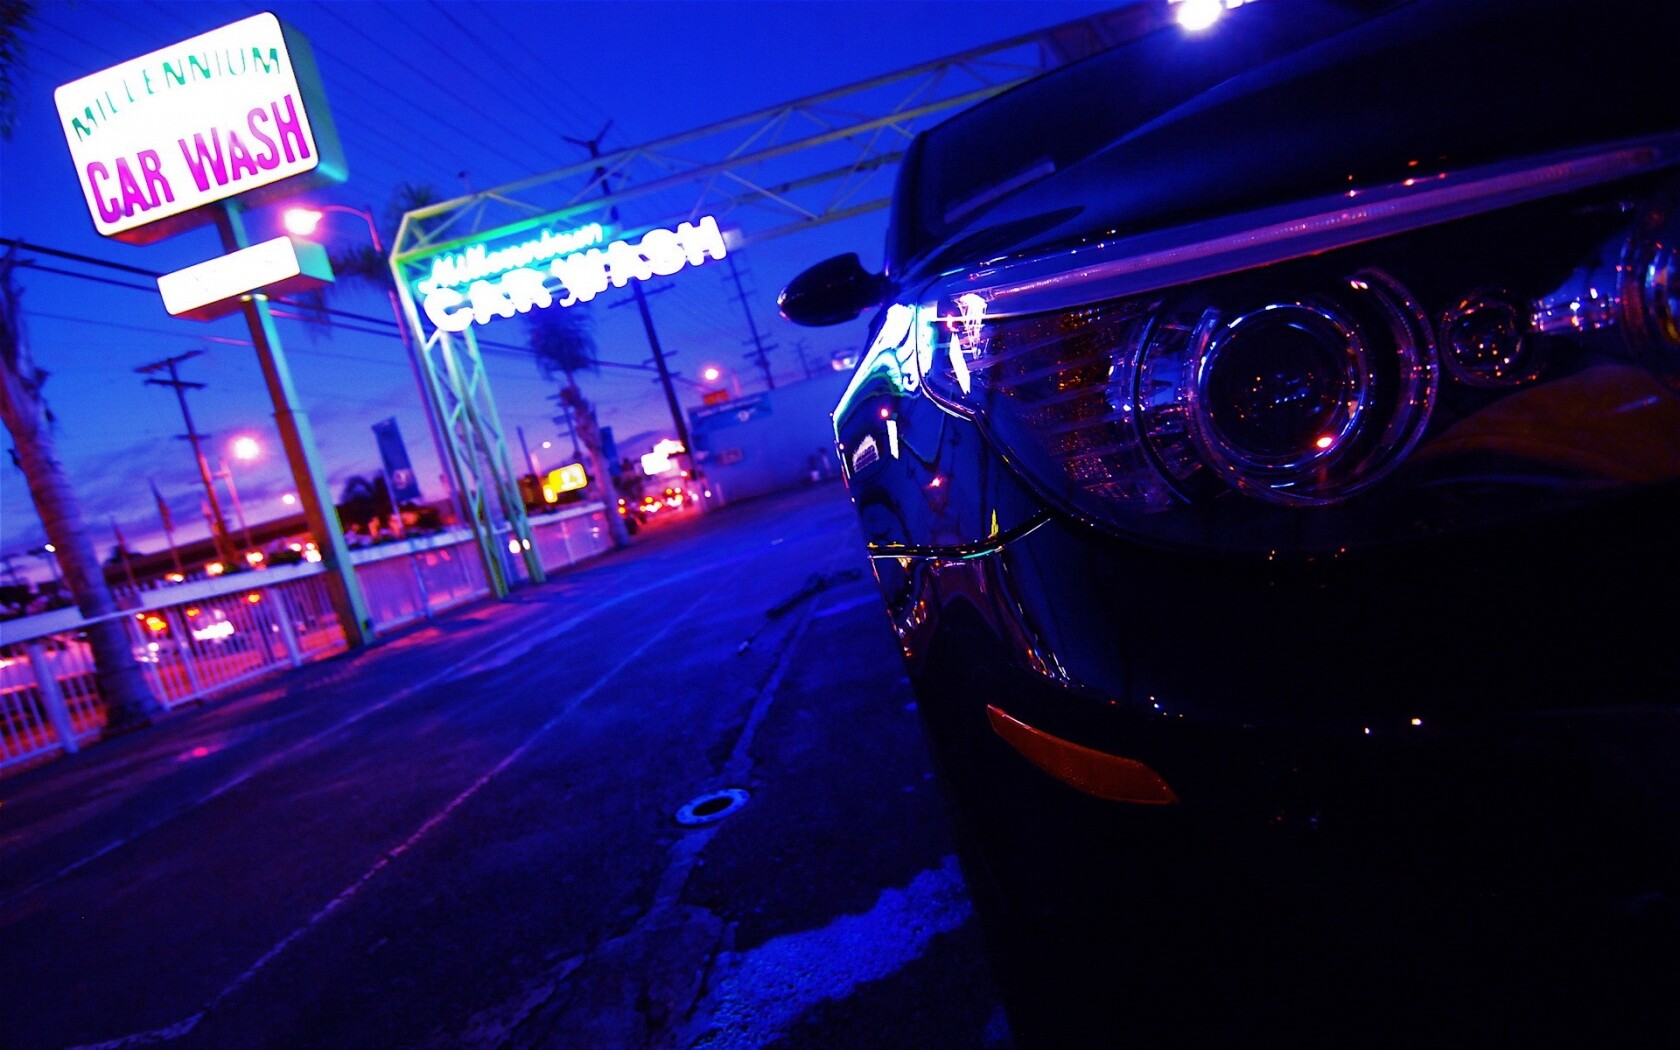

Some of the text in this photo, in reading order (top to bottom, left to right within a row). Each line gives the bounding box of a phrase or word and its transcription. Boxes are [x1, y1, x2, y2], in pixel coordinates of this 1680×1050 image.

[71, 47, 281, 142] MILLENNIUM
[87, 94, 311, 224] CAR WASH
[423, 215, 727, 332] CAR WASH
